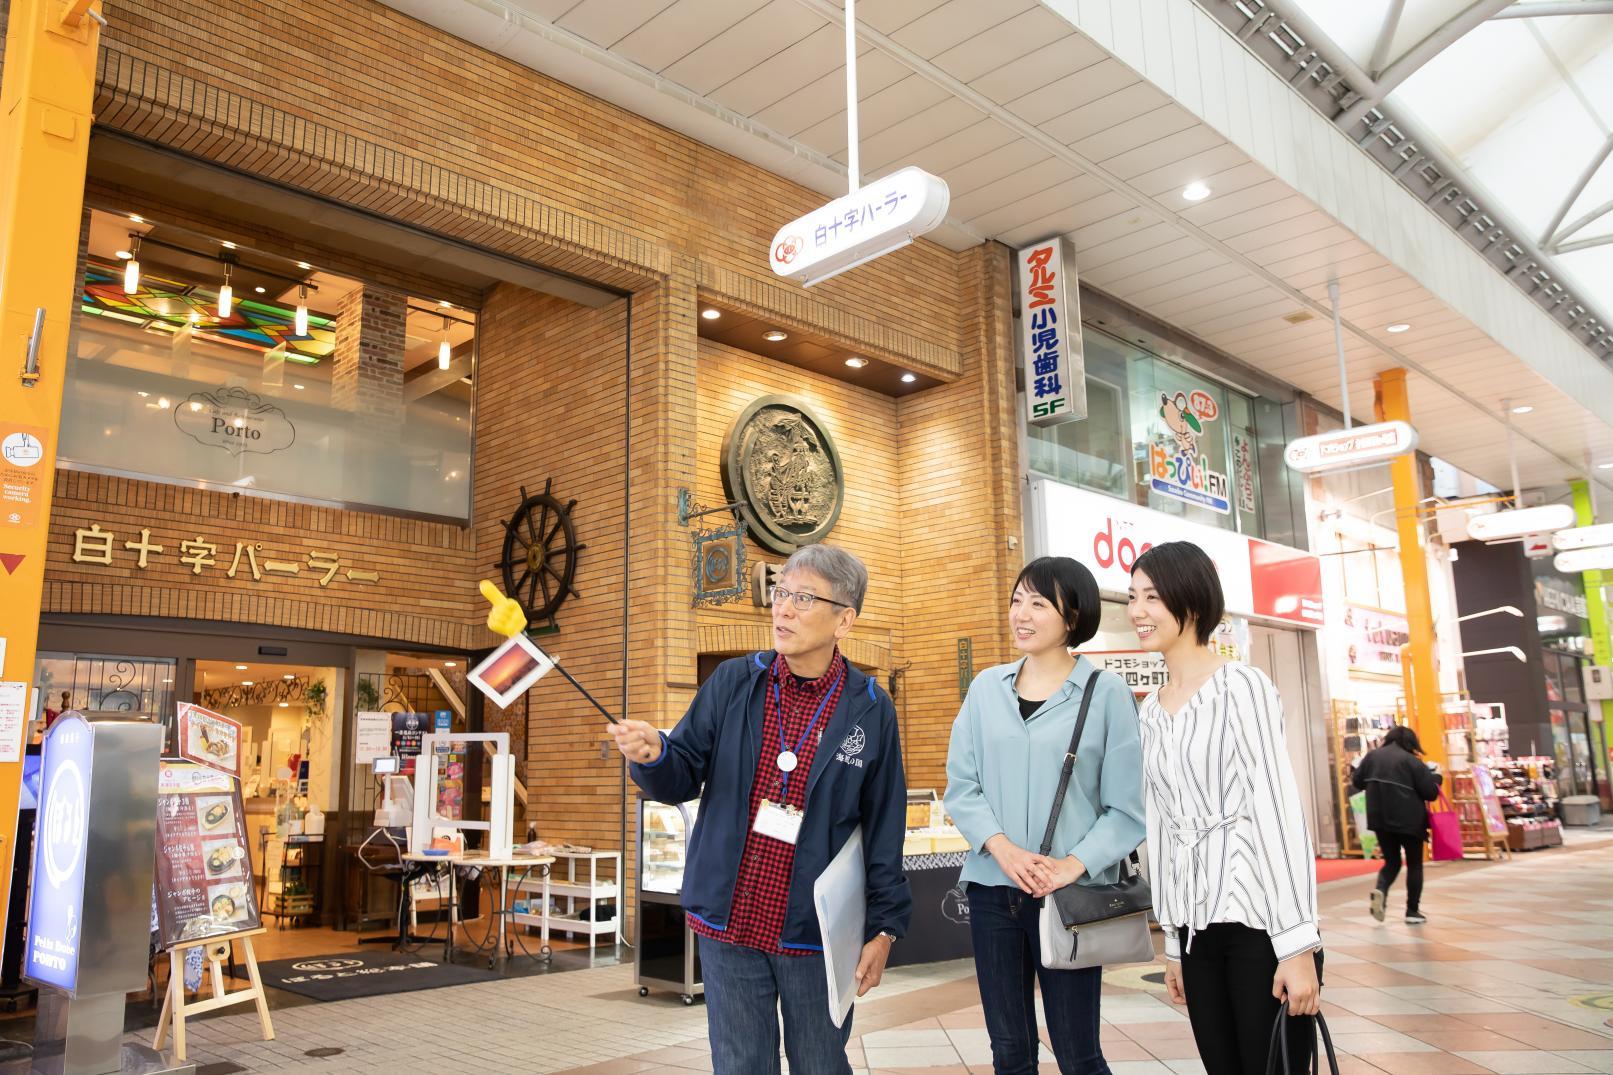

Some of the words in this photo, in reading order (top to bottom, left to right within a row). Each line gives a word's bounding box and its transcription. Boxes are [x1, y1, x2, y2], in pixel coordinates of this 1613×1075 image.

[1027, 246, 1062, 398] タルミ小児歯科
[210, 416, 261, 440] Porto
[1033, 397, 1065, 418] 5F
[72, 524, 381, 587] 白十字パーラー
